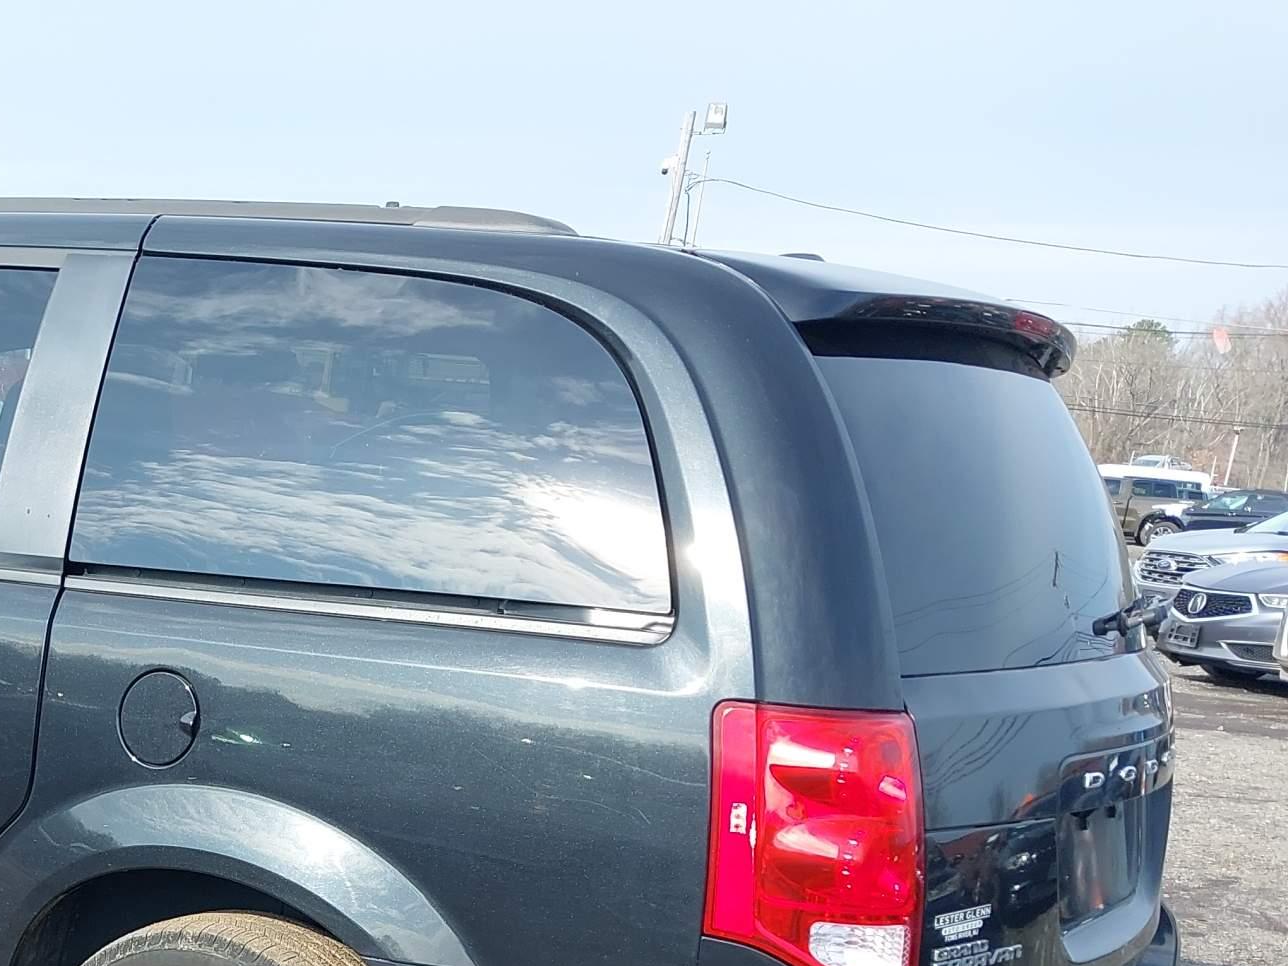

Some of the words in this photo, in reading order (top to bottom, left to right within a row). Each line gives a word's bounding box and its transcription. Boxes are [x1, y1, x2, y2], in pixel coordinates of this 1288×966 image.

[1084, 747, 1174, 789] DOD
[935, 913, 964, 927] LESTER
[966, 906, 992, 919] GLENN
[934, 940, 990, 961] GRAND
